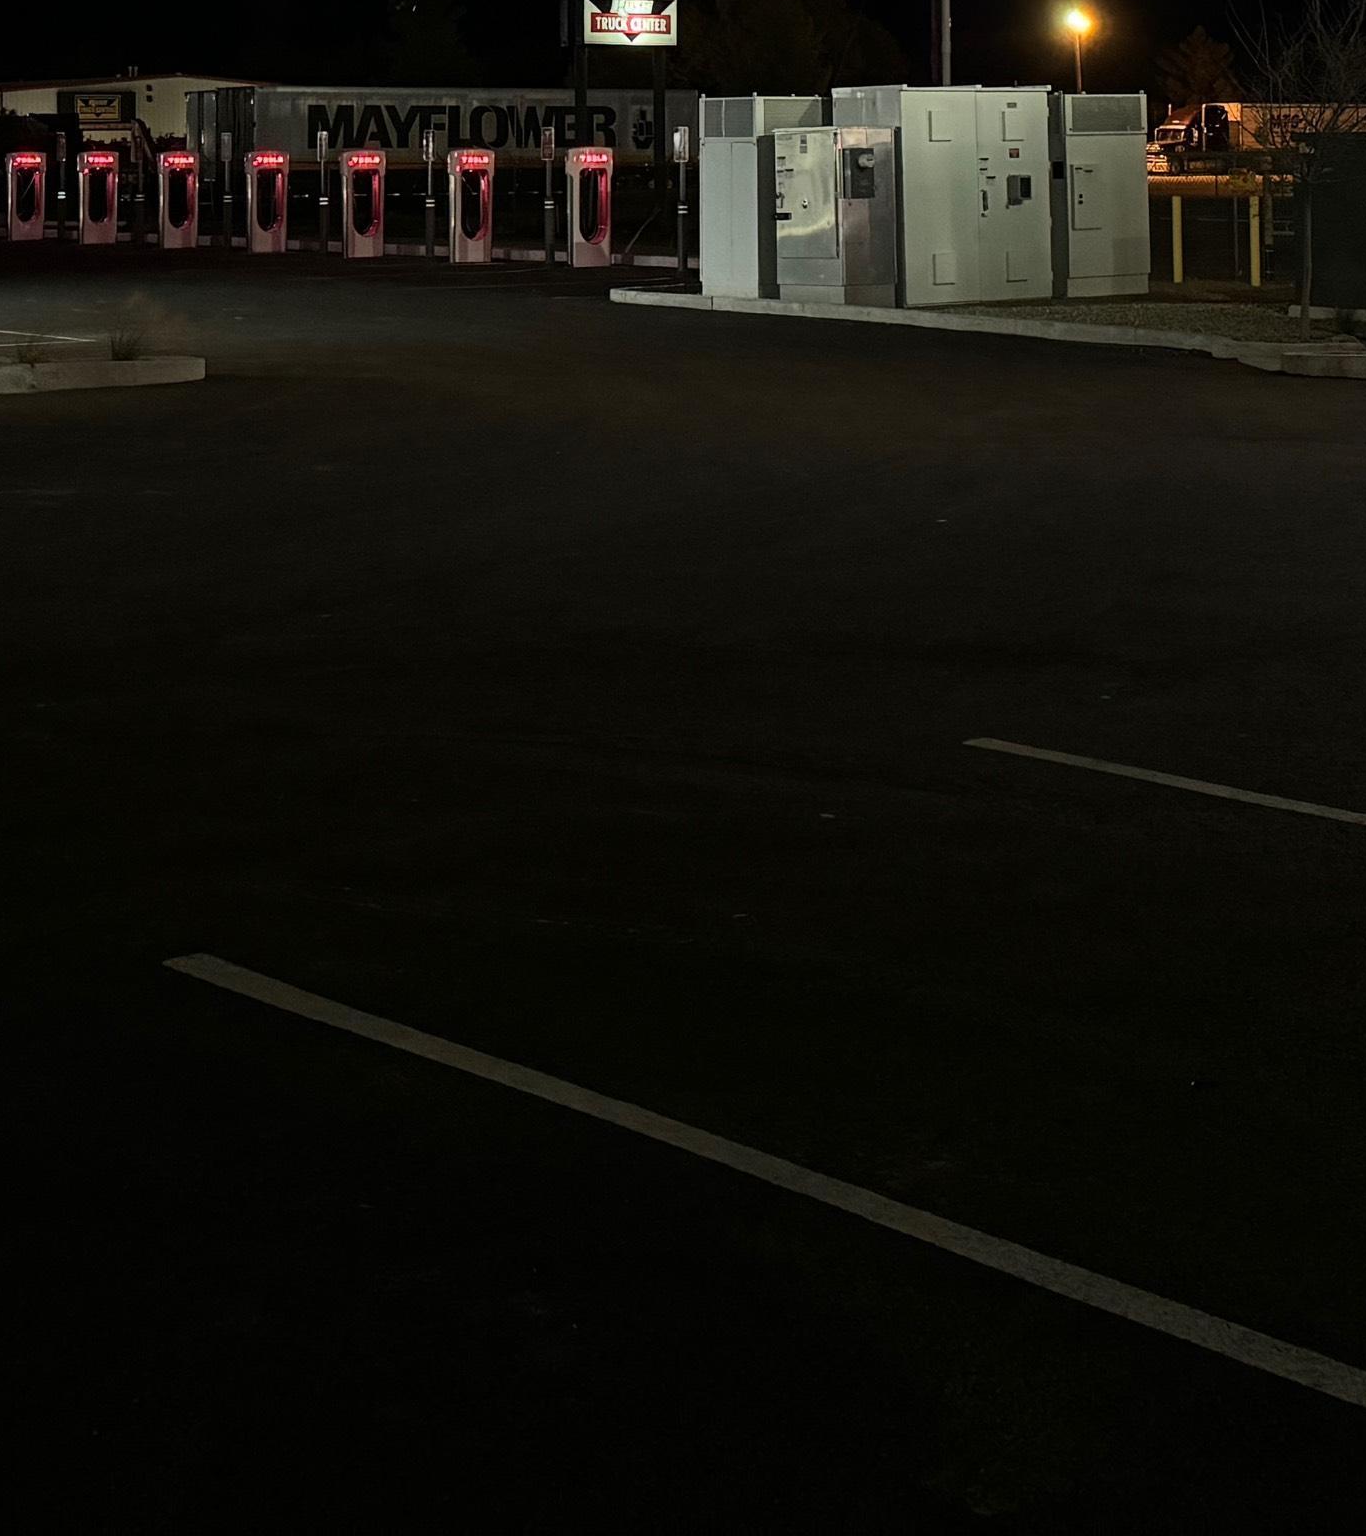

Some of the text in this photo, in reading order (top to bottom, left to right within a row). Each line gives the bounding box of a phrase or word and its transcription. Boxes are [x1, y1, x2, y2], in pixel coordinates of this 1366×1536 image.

[596, 16, 666, 32] TRUCK CENTER
[307, 104, 616, 149] MAYFLOWER
